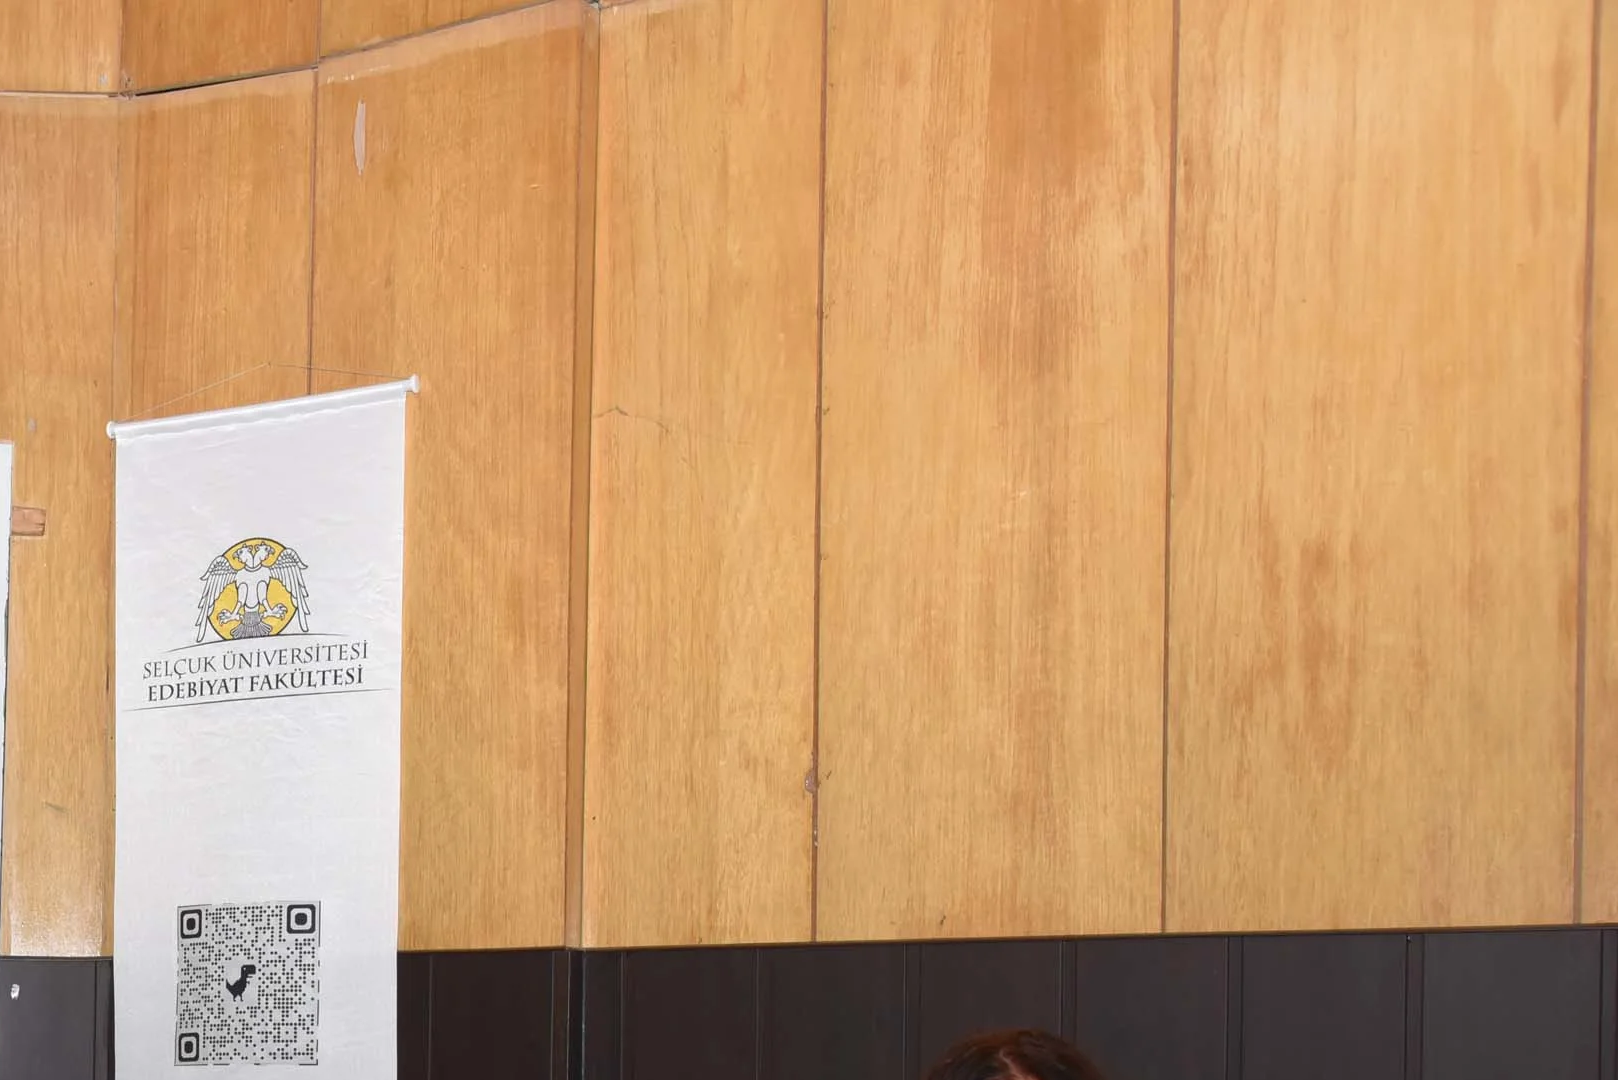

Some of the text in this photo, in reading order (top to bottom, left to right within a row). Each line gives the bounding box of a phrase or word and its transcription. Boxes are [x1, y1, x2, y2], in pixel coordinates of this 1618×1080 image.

[143, 639, 368, 680] SELÇUK ÜNİVERSİTESİ
[149, 663, 364, 702] EDEBİYAT FAKÜLTESİ
